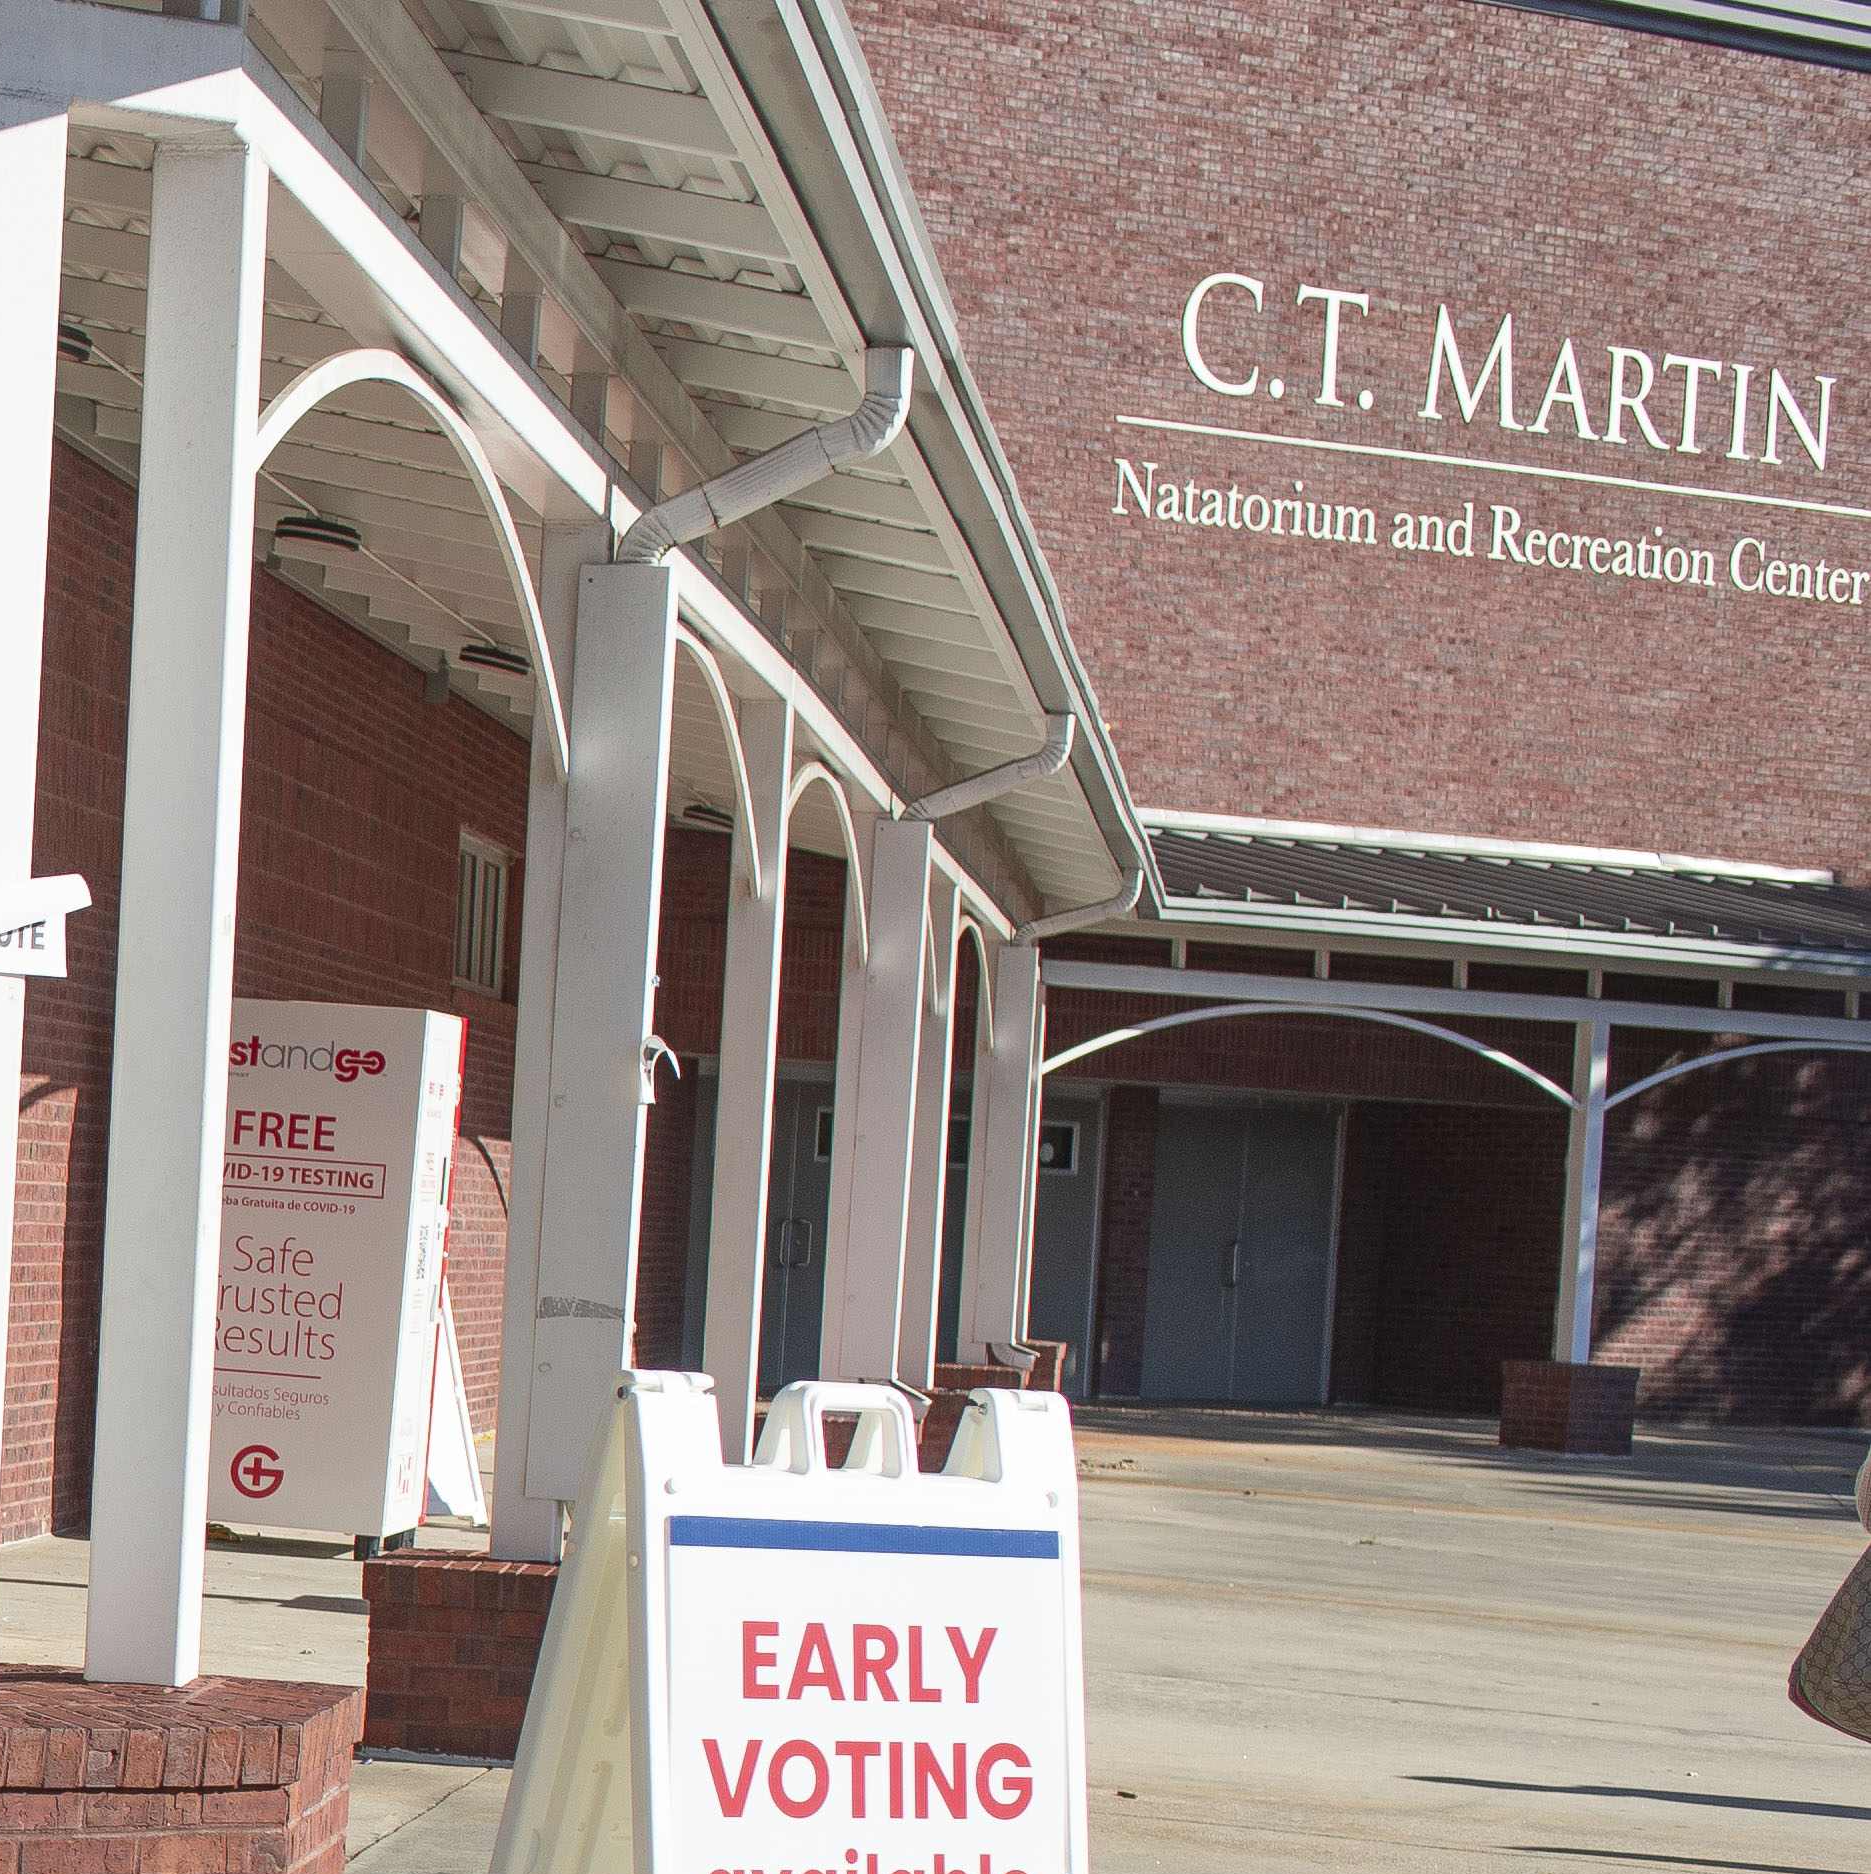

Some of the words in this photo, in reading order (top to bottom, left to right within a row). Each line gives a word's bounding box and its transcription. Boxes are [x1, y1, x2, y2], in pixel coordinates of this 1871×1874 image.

[1181, 272, 1375, 411] C.T.
[1417, 301, 1837, 471] MARTIN
[1112, 458, 1377, 546] Natatorium
[1392, 501, 1474, 557] and
[1488, 502, 1716, 586] Recreation
[1730, 537, 1871, 605] Center
[232, 1109, 336, 1152] FREE
[289, 1167, 374, 1189] TESTING
[241, 1196, 284, 1209] Gratuita
[288, 1199, 301, 1211] de
[303, 1201, 356, 1215] COVID-19
[233, 1235, 314, 1277] Safe
[219, 1279, 343, 1320] rusted
[216, 1404, 224, 1417] y
[227, 1401, 301, 1420] Confiables
[273, 1387, 329, 1405] Seguros
[742, 1620, 998, 1704] EARLY
[701, 1738, 1033, 1820] VOTING
